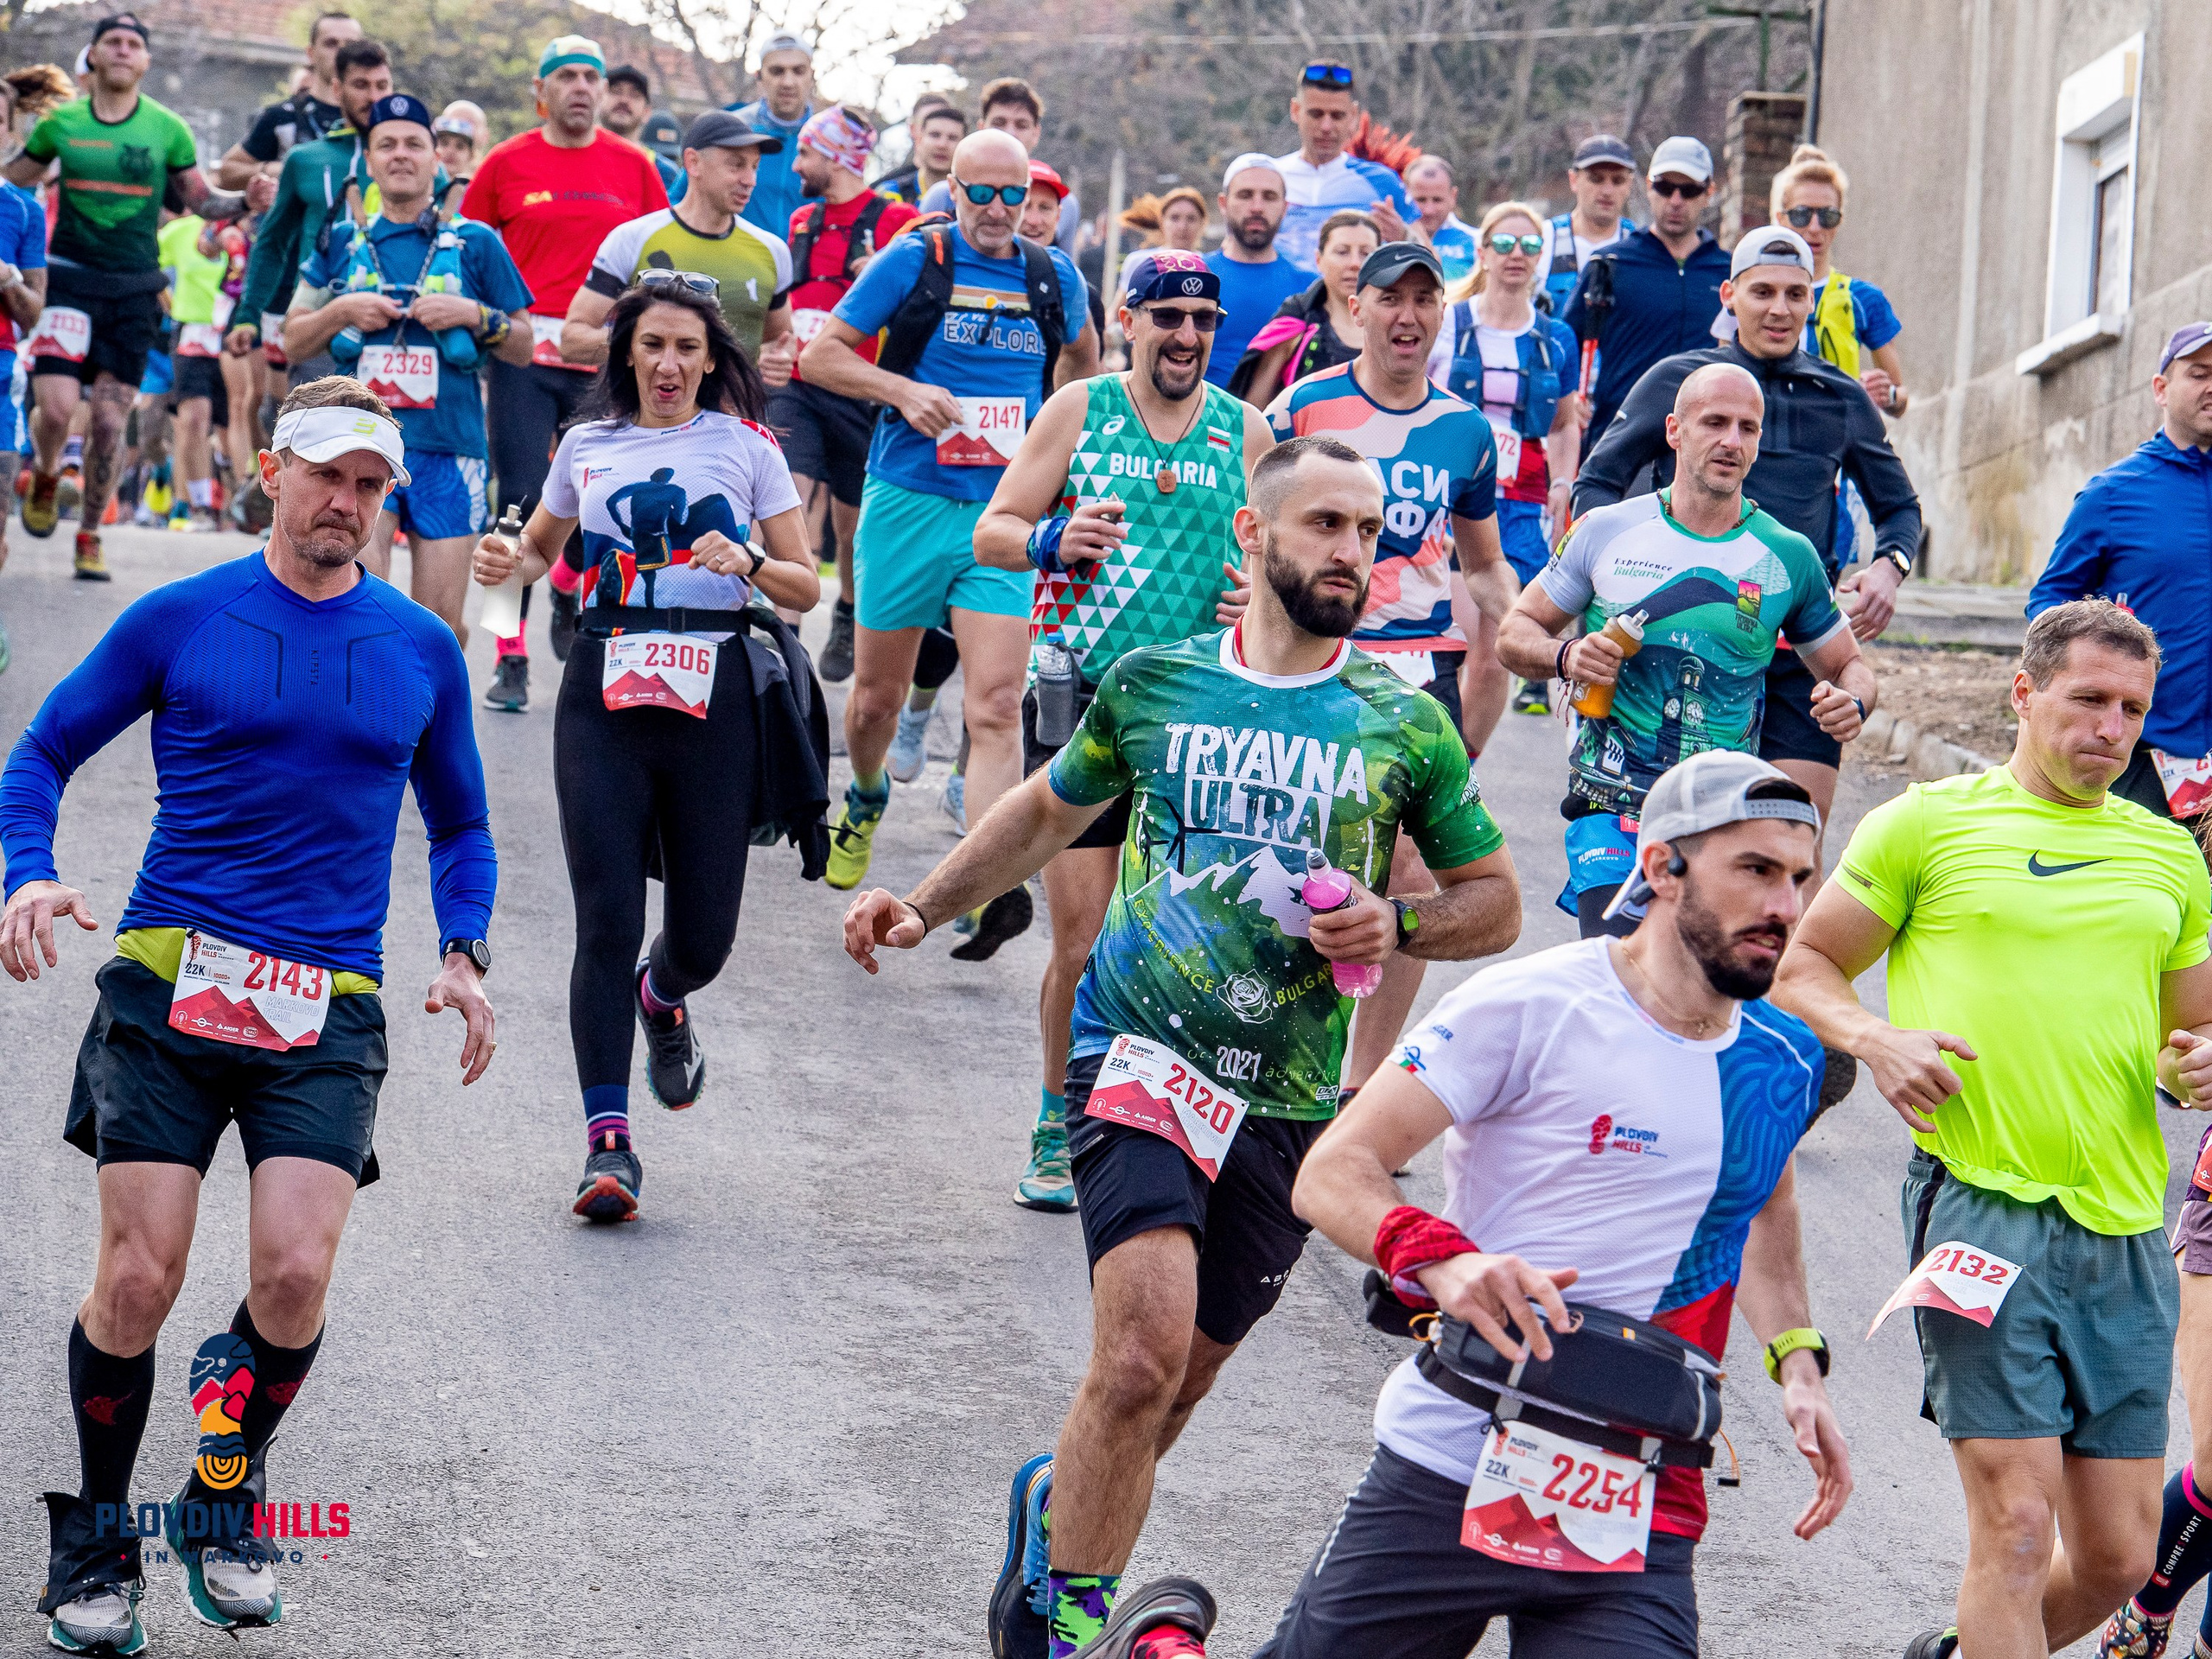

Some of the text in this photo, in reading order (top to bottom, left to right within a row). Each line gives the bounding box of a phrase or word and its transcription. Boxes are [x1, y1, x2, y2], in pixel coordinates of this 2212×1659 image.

[383, 353, 432, 376] 2329
[978, 405, 1020, 429] 2147
[1493, 431, 1516, 456] 72
[1613, 566, 1664, 580] Bulgaria
[1614, 557, 1673, 572] Experience
[310, 650, 319, 685] KIPSTA
[645, 642, 710, 676] 2306
[1165, 722, 1368, 805] TRYAVNA
[1188, 779, 1323, 848] ULTRA
[1578, 847, 1630, 865] PLOVDIV HILLS
[201, 950, 218, 958] HILLS
[202, 943, 227, 952] PLOVDIV
[1134, 898, 1215, 995] EXPERIENCE
[184, 963, 207, 976] 22K
[243, 950, 324, 1001] 2143
[1275, 963, 1333, 1005] BULGAR
[263, 1007, 292, 1024] TRAIL
[265, 995, 320, 1017] MARKOVO
[1128, 1049, 1145, 1058] HILLS
[1129, 1044, 1155, 1055] PLOVDIV
[1109, 1057, 1131, 1071] 22K
[1217, 1046, 1262, 1083] 2021
[1162, 1063, 1236, 1135] 2120
[1925, 1249, 2009, 1286] 2132
[1484, 1459, 1510, 1478] 22K
[1541, 1452, 1642, 1518] 2254
